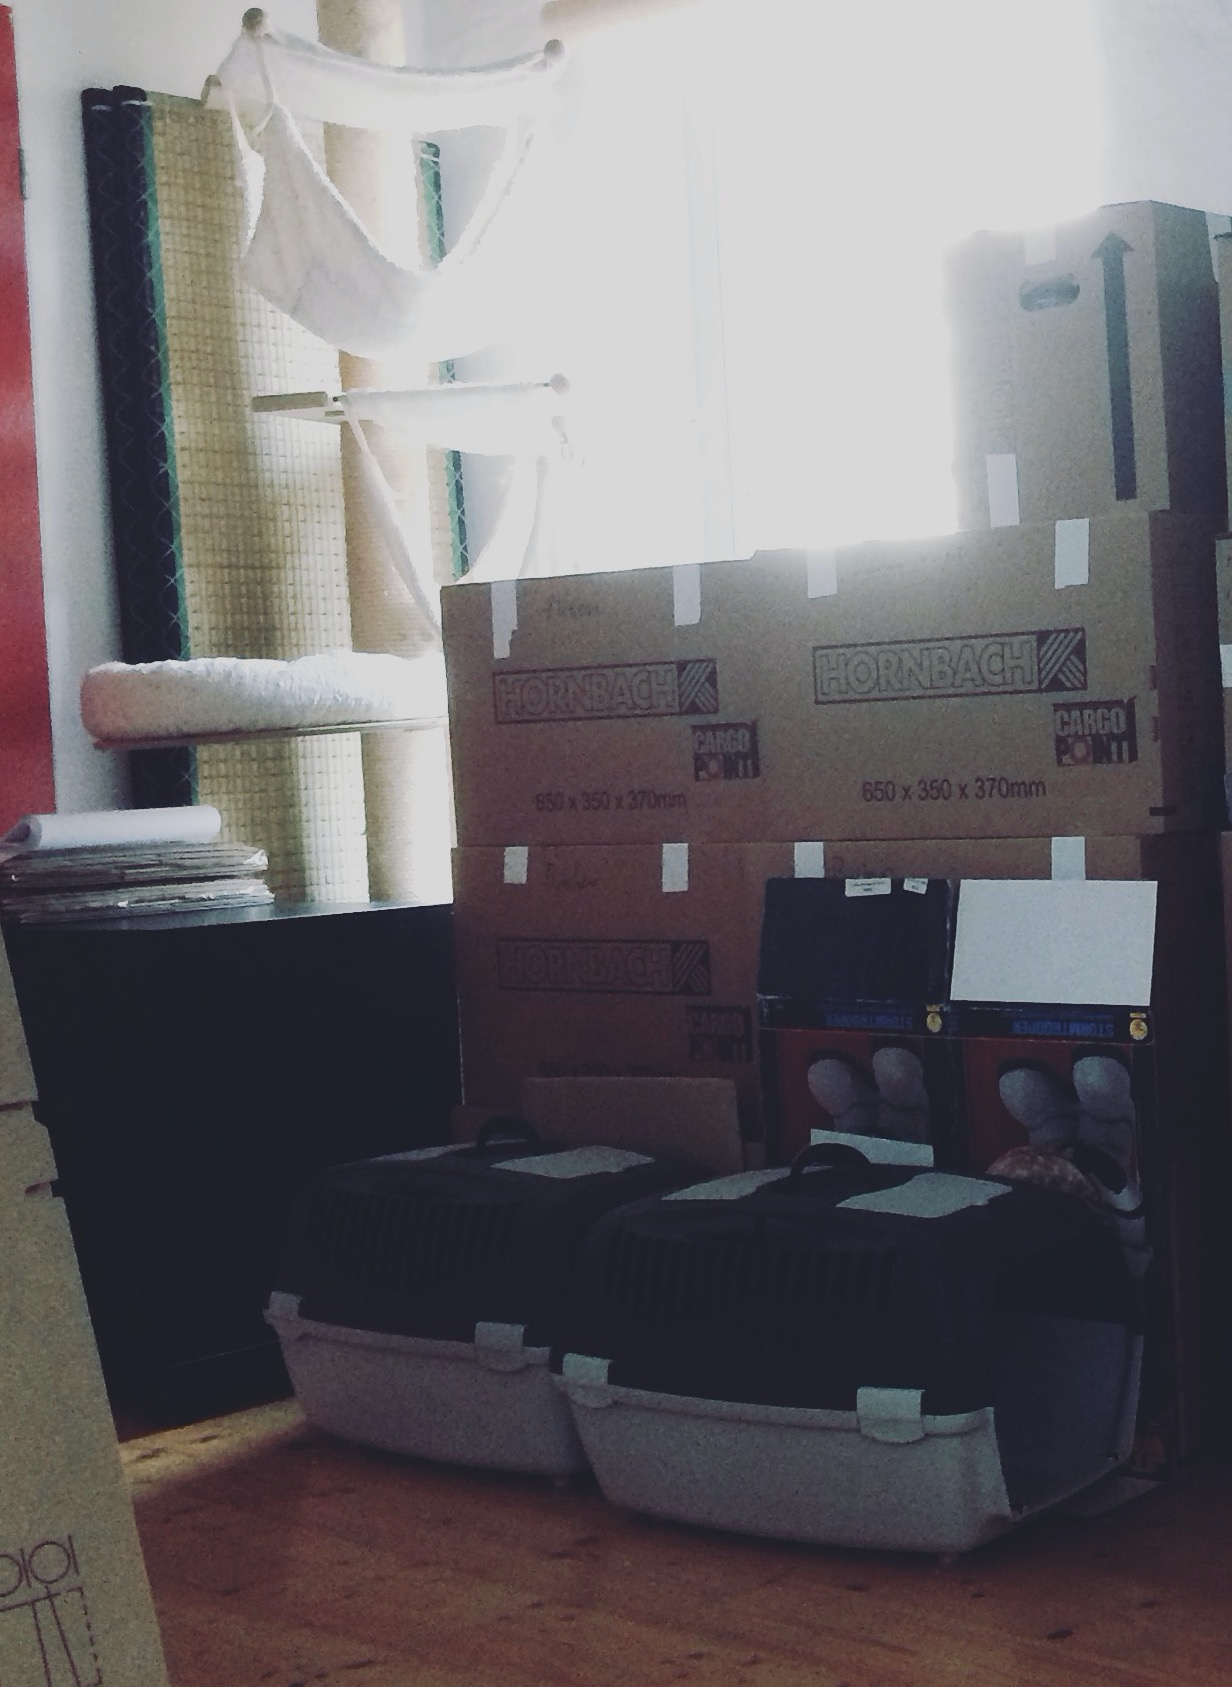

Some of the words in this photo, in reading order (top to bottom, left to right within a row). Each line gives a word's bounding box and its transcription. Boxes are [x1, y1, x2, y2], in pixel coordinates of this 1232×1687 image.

[817, 639, 1036, 697] HORNBACH
[497, 667, 678, 718] HORNBACH
[1055, 706, 1129, 738] CARGO
[535, 792, 566, 813] 650
[627, 789, 688, 811] 370mm
[861, 779, 896, 803] 650
[900, 784, 912, 801] x
[917, 778, 951, 801] 350
[957, 783, 968, 799] x
[974, 775, 1048, 800] 370mm
